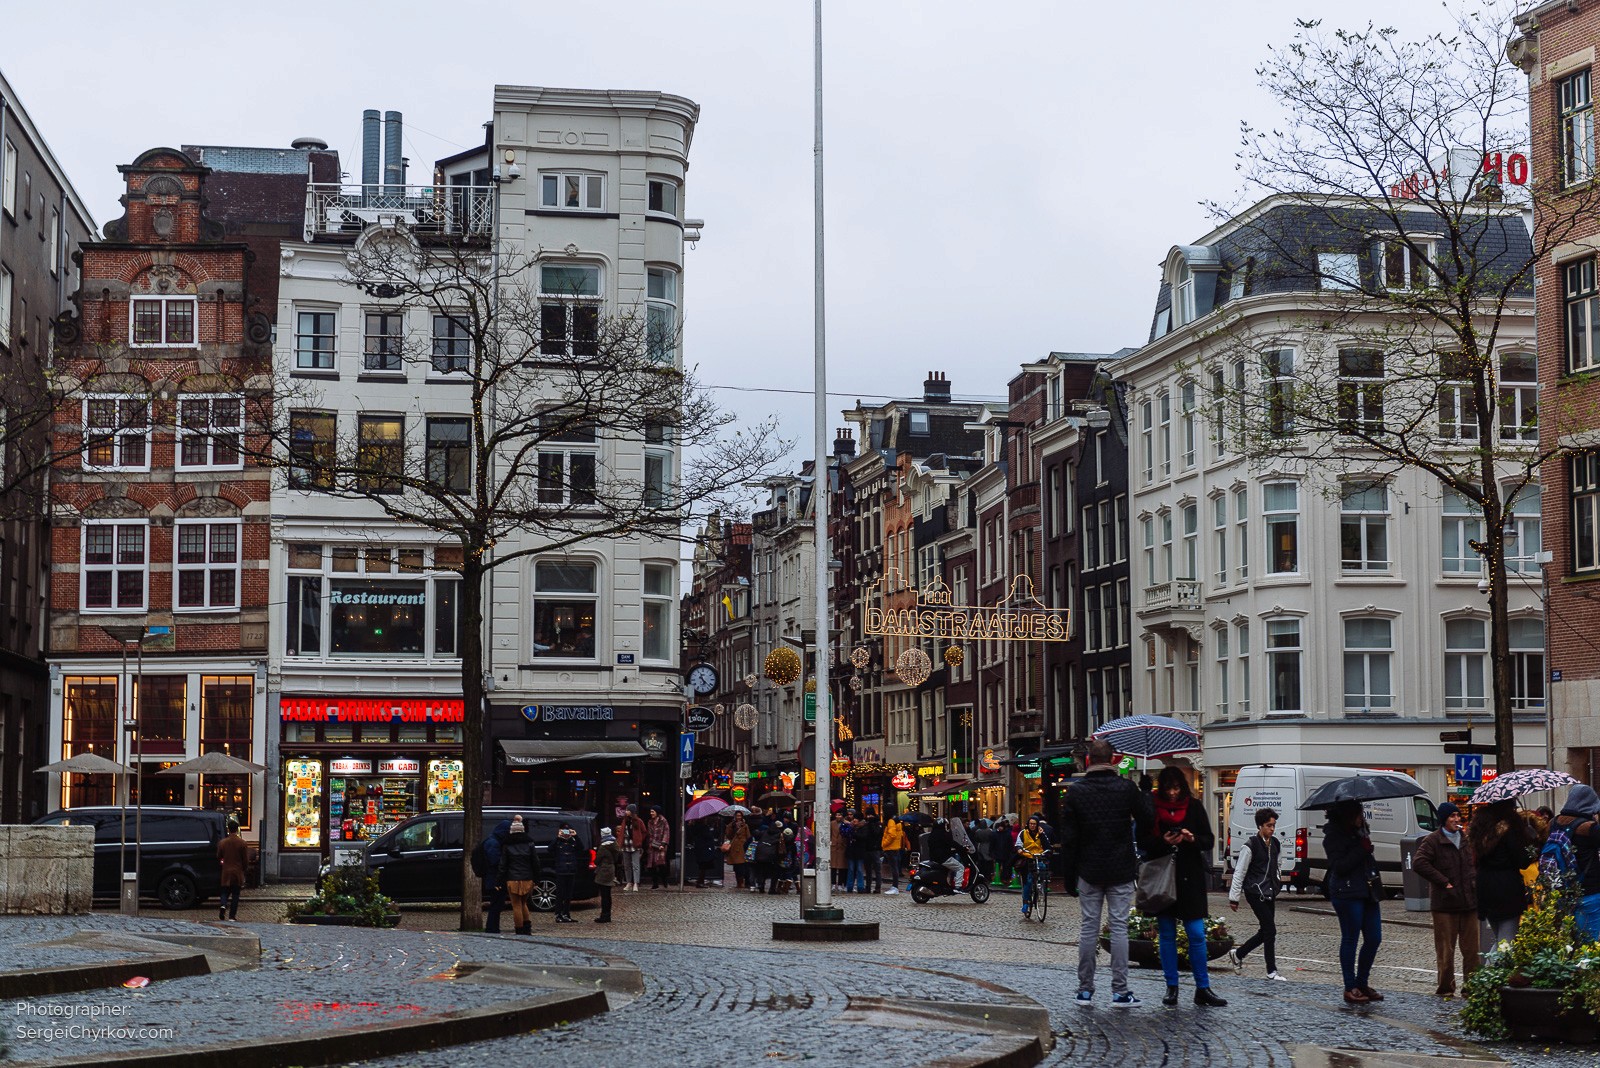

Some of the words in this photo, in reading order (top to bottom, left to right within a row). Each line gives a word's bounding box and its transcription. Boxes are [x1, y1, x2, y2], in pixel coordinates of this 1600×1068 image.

[330, 591, 426, 605] Restaurant
[866, 607, 1065, 640] DAMSTRAATJES
[281, 701, 330, 722] TABAK
[337, 701, 393, 722] DRINKS
[400, 702, 427, 723] SIM
[541, 704, 614, 721] Bavaria
[380, 762, 394, 771] SIM
[398, 762, 419, 771] CARD
